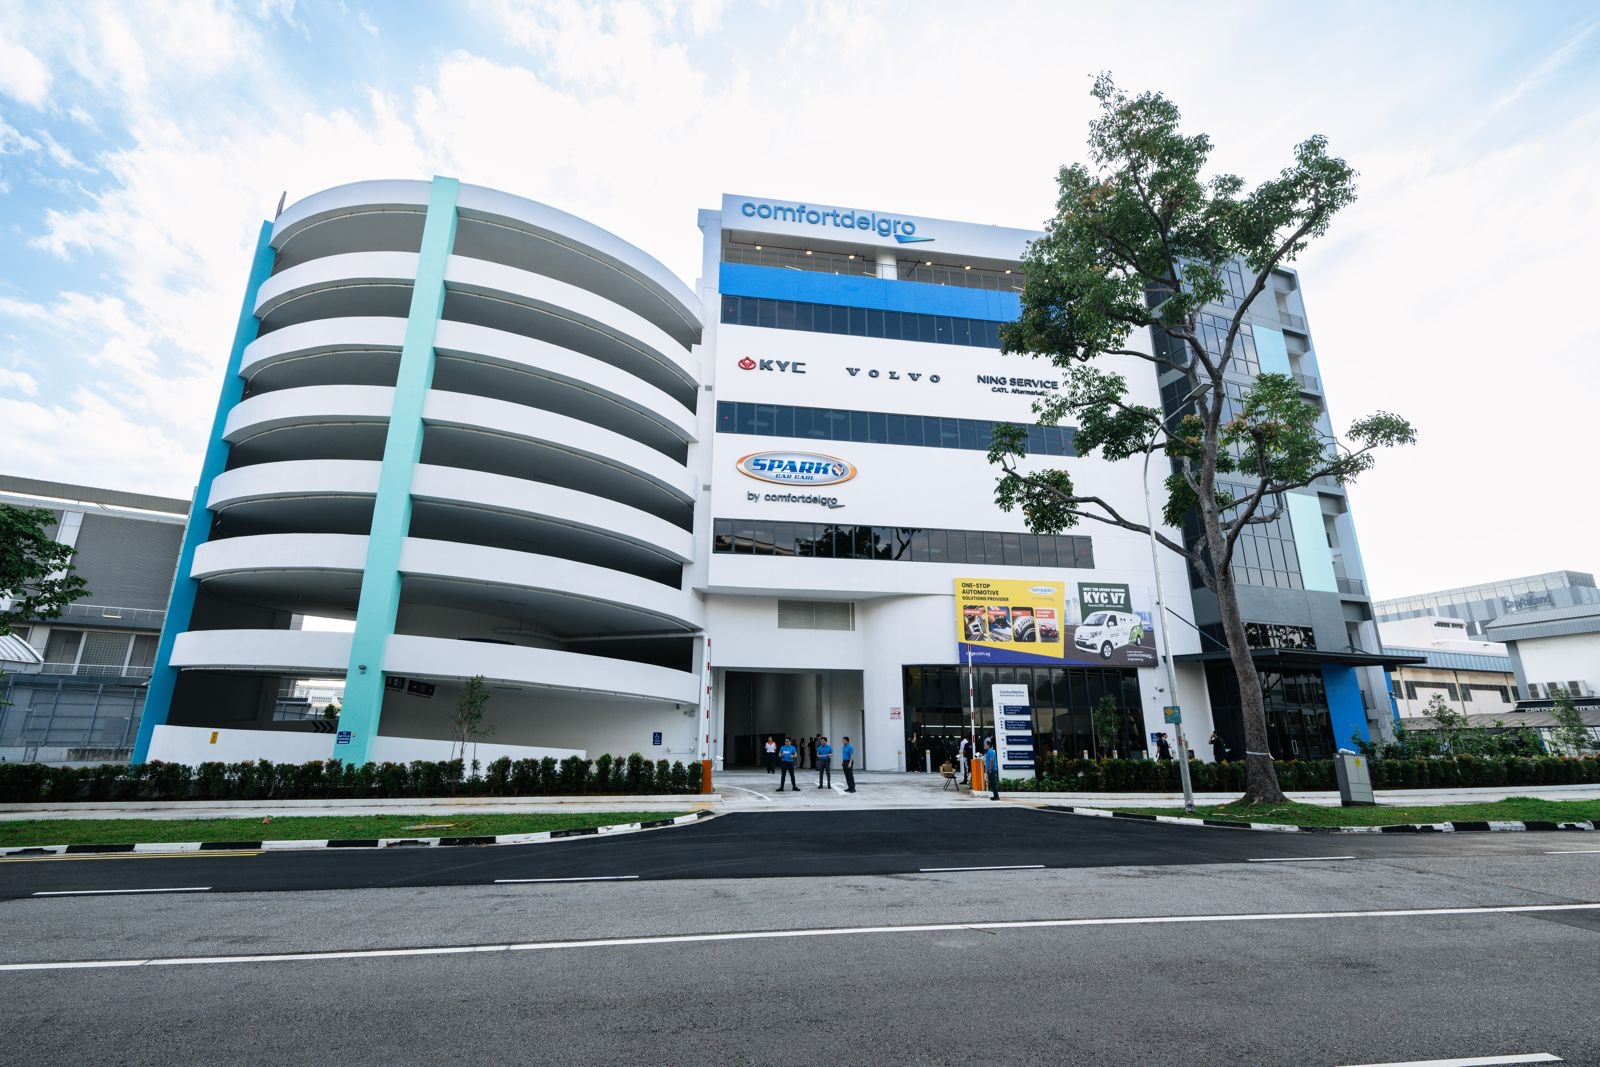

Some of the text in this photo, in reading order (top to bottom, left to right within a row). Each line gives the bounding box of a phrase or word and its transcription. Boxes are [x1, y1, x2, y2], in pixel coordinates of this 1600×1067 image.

[741, 202, 916, 237] comfortdelgro
[759, 359, 806, 374] KYC
[846, 367, 941, 383] VOLVO
[977, 374, 1059, 390] NING SERVICE
[991, 386, 1009, 394] CATL
[752, 458, 832, 475] SPARK
[747, 491, 838, 507] by comfortdelgro
[1083, 591, 1126, 605] KYC V7
